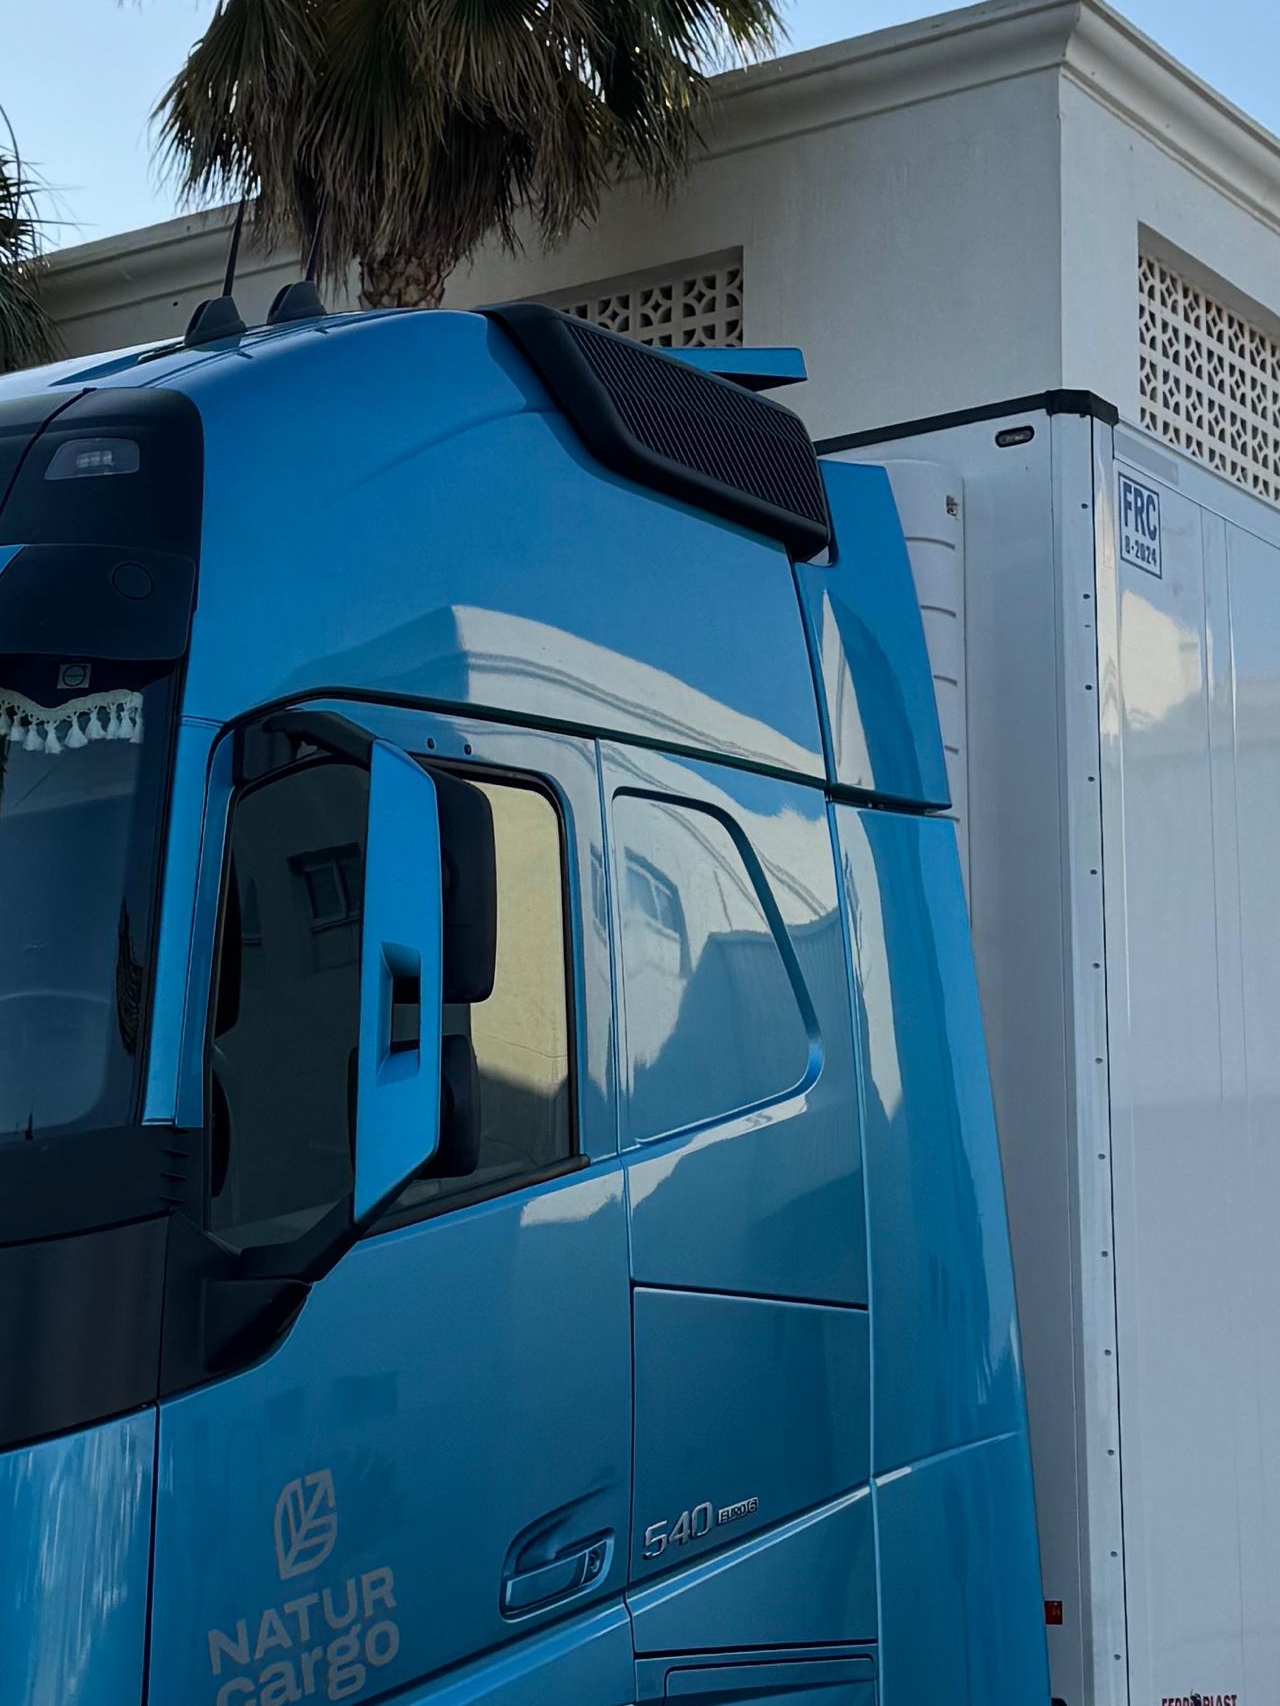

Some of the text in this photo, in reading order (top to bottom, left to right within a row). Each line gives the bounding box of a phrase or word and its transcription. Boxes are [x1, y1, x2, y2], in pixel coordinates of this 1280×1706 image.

[1122, 480, 1157, 541] FRC
[642, 1501, 714, 1559] 540
[208, 1566, 397, 1676] NATUR
